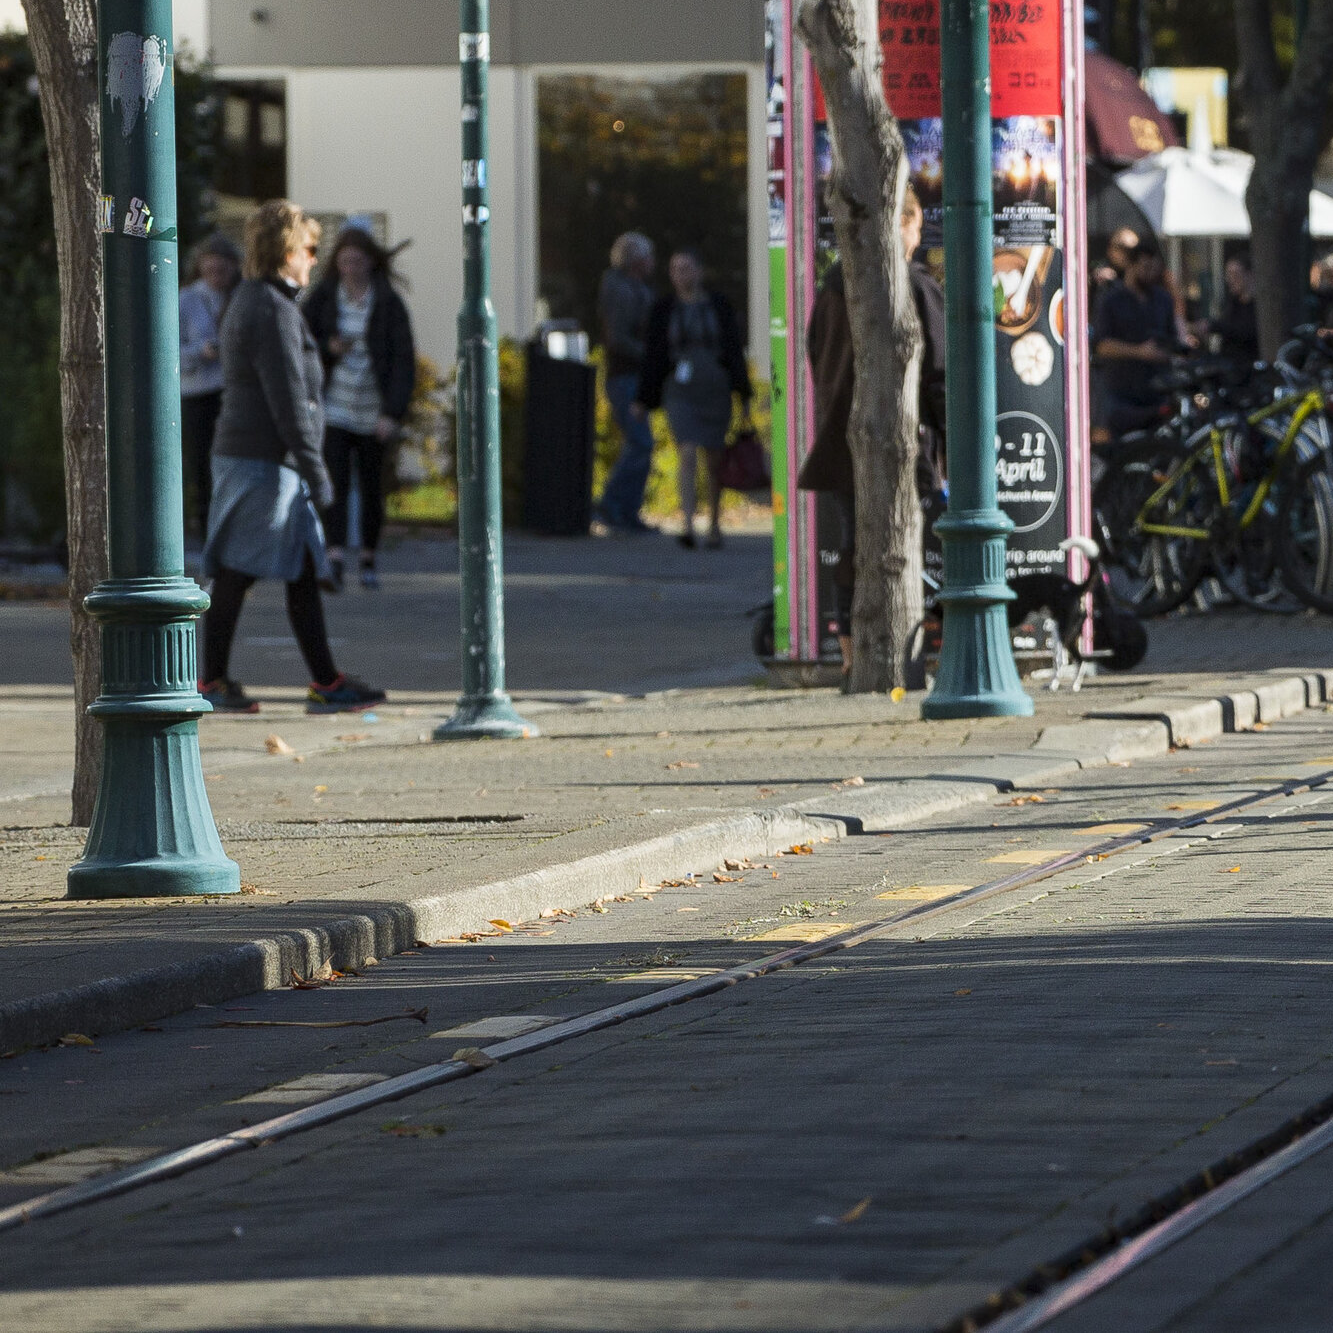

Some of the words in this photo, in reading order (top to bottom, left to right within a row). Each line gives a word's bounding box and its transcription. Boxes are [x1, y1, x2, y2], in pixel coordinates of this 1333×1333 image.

[1019, 432, 1047, 457] 11
[995, 457, 1047, 487] April
[1026, 548, 1066, 564] around
